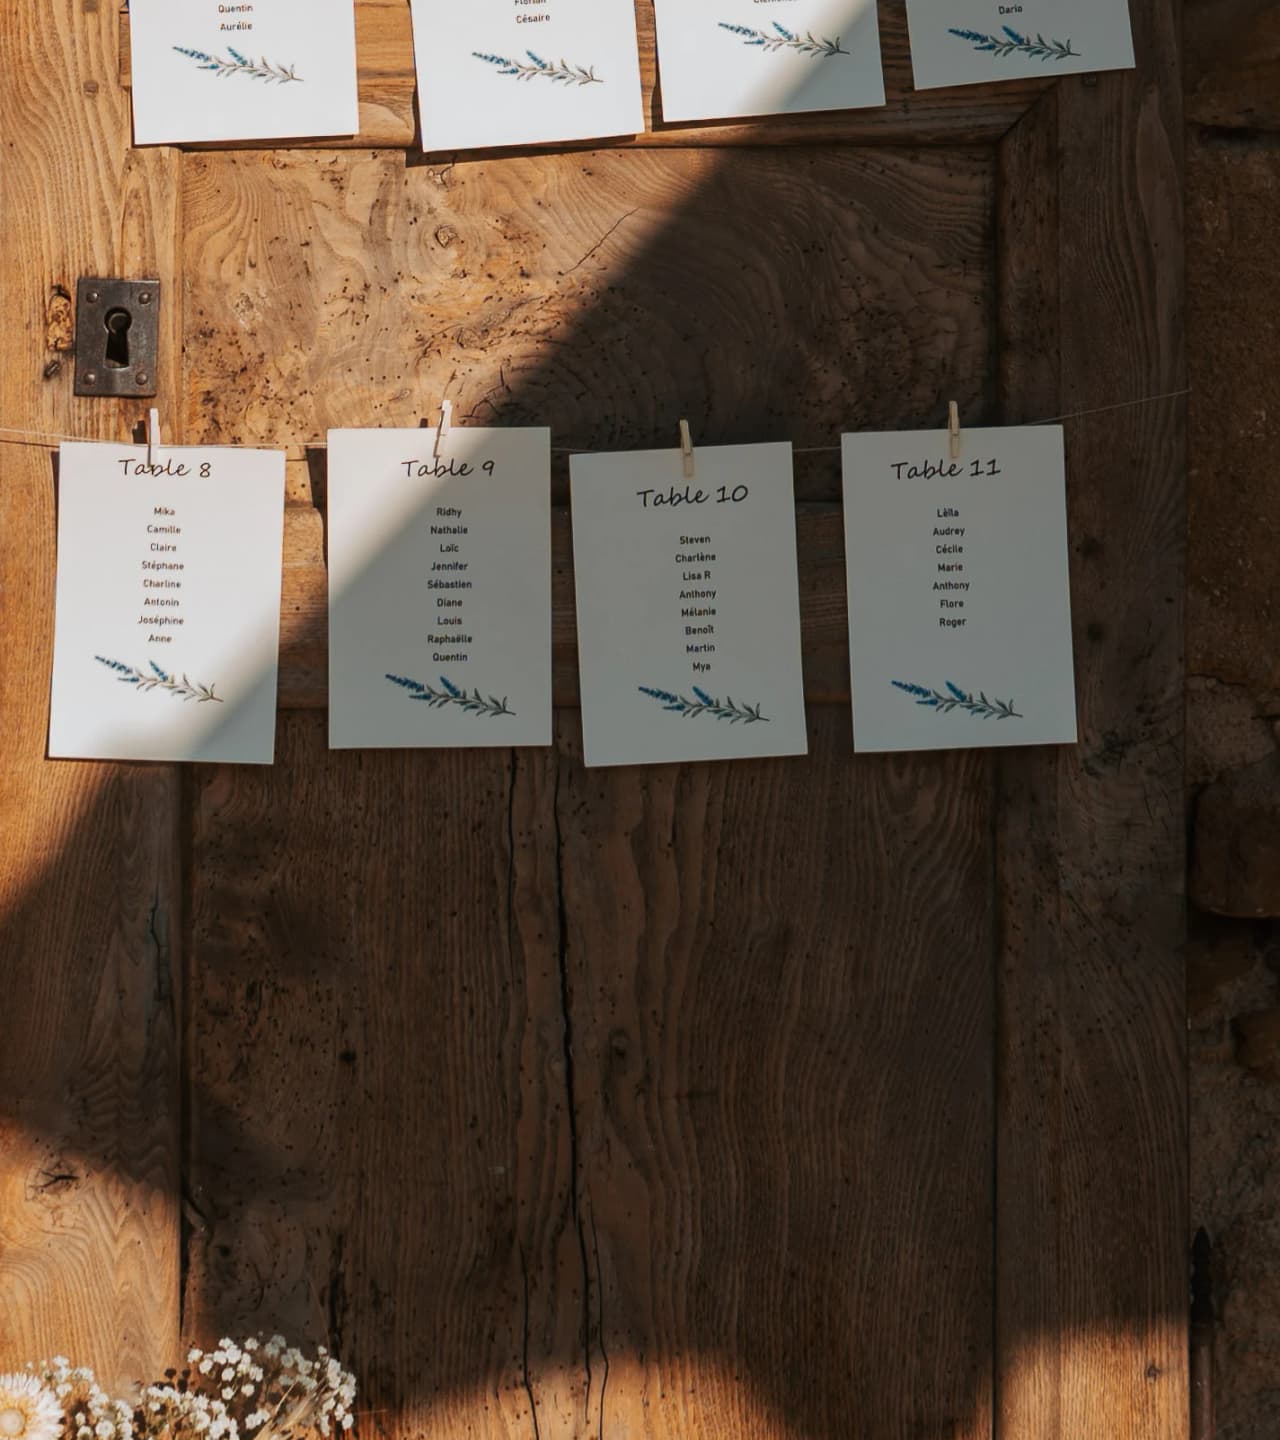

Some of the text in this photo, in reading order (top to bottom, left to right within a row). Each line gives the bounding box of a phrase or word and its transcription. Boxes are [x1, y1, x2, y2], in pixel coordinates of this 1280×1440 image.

[217, 3, 254, 14] Quentin
[997, 3, 1023, 16] Dario
[219, 20, 253, 32] Aurélie
[199, 462, 212, 479] 8
[400, 455, 496, 479] Table 9
[890, 458, 1002, 481] Table 11
[636, 484, 749, 508] Table 10
[153, 506, 176, 516] Mika
[146, 524, 182, 535] Camille
[429, 524, 469, 535] Nathalie
[932, 526, 966, 537] Audrey
[679, 535, 711, 545] Steven
[150, 542, 177, 553] Claire
[935, 543, 964, 555] Cécile
[141, 559, 185, 572] Stéphane
[430, 560, 469, 572] Jennifer
[937, 562, 964, 573] Marie
[682, 569, 712, 582] Lisa R
[142, 578, 182, 589] Charline
[426, 578, 473, 590] Sébastien
[932, 580, 971, 592] Anthony
[679, 589, 717, 601] Anthony
[143, 597, 180, 607] Antonin
[436, 597, 463, 608] Diane
[680, 607, 717, 618] Mélanie
[137, 615, 185, 627] Joséphine
[436, 615, 463, 626] Louis
[938, 617, 967, 629] Roger
[147, 633, 173, 644] Anne
[685, 642, 716, 654] Martin
[432, 651, 468, 663] Quentin
[692, 661, 712, 673] Mya
